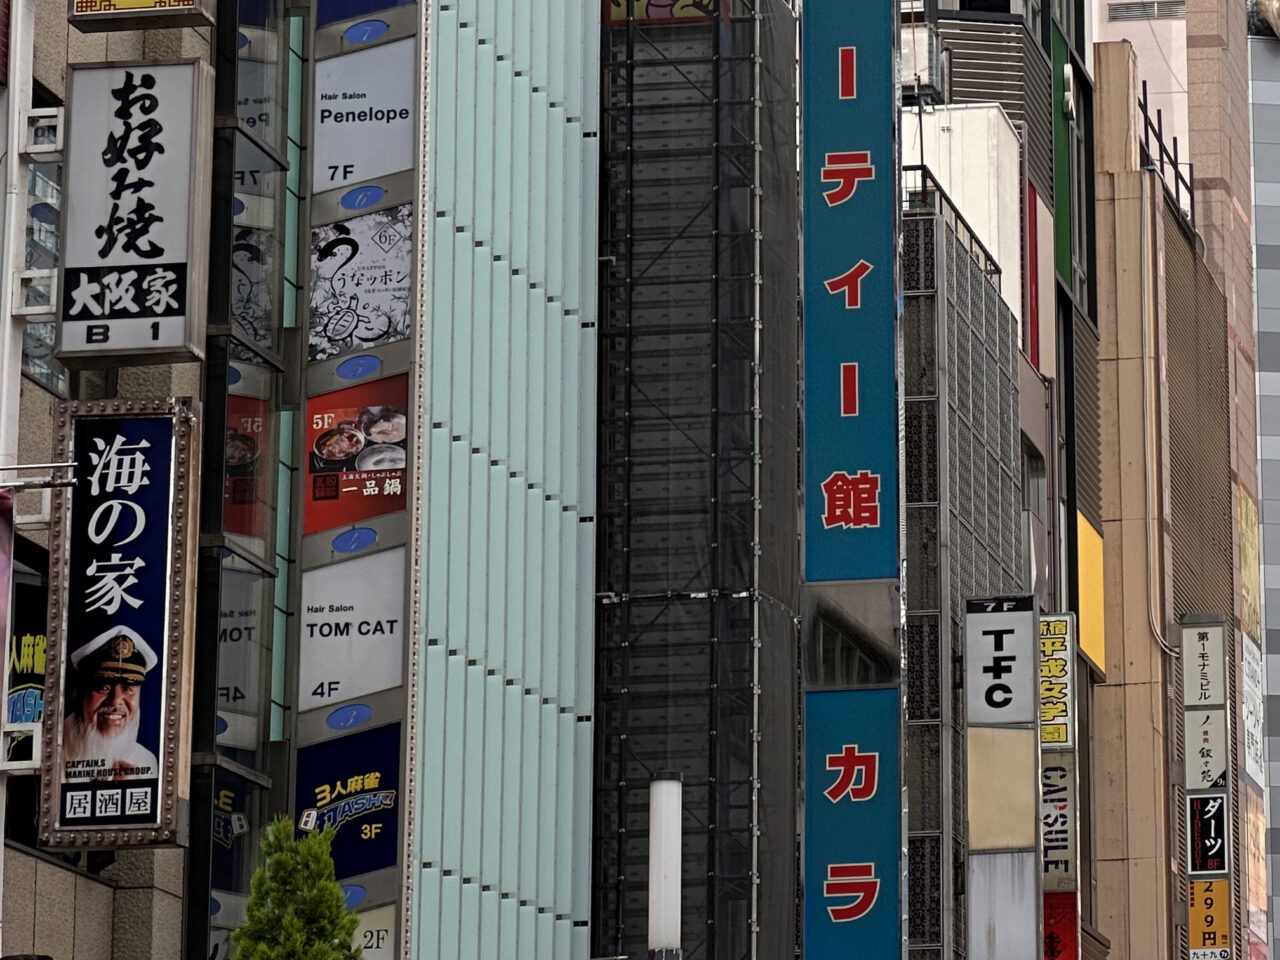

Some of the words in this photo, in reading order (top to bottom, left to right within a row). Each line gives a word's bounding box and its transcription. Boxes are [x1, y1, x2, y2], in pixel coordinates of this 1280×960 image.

[321, 93, 339, 101] Hair
[342, 91, 366, 101] Salon
[320, 107, 409, 124] Penelope
[95, 71, 164, 260] お好み焼
[328, 164, 354, 181] 7F
[379, 230, 396, 245] 6F
[70, 270, 179, 319] 大阪家
[313, 414, 335, 429] 5F
[342, 478, 401, 496] 一品鍋
[85, 435, 151, 616] 海の家
[307, 604, 327, 613] Hair
[329, 602, 354, 613] Salon
[983, 602, 1016, 612] 7F
[306, 621, 350, 638] TOM
[357, 618, 398, 637] CAT
[311, 681, 341, 698] 4F
[65, 769, 95, 779] MARINE
[315, 772, 381, 807] 3人麻雀
[68, 790, 150, 816] 居酒屋
[361, 823, 383, 839] 3F
[823, 744, 880, 923] カラ
[1204, 798, 1222, 856] ダーツ
[1207, 859, 1221, 870] 8F
[363, 929, 388, 949] 2F
